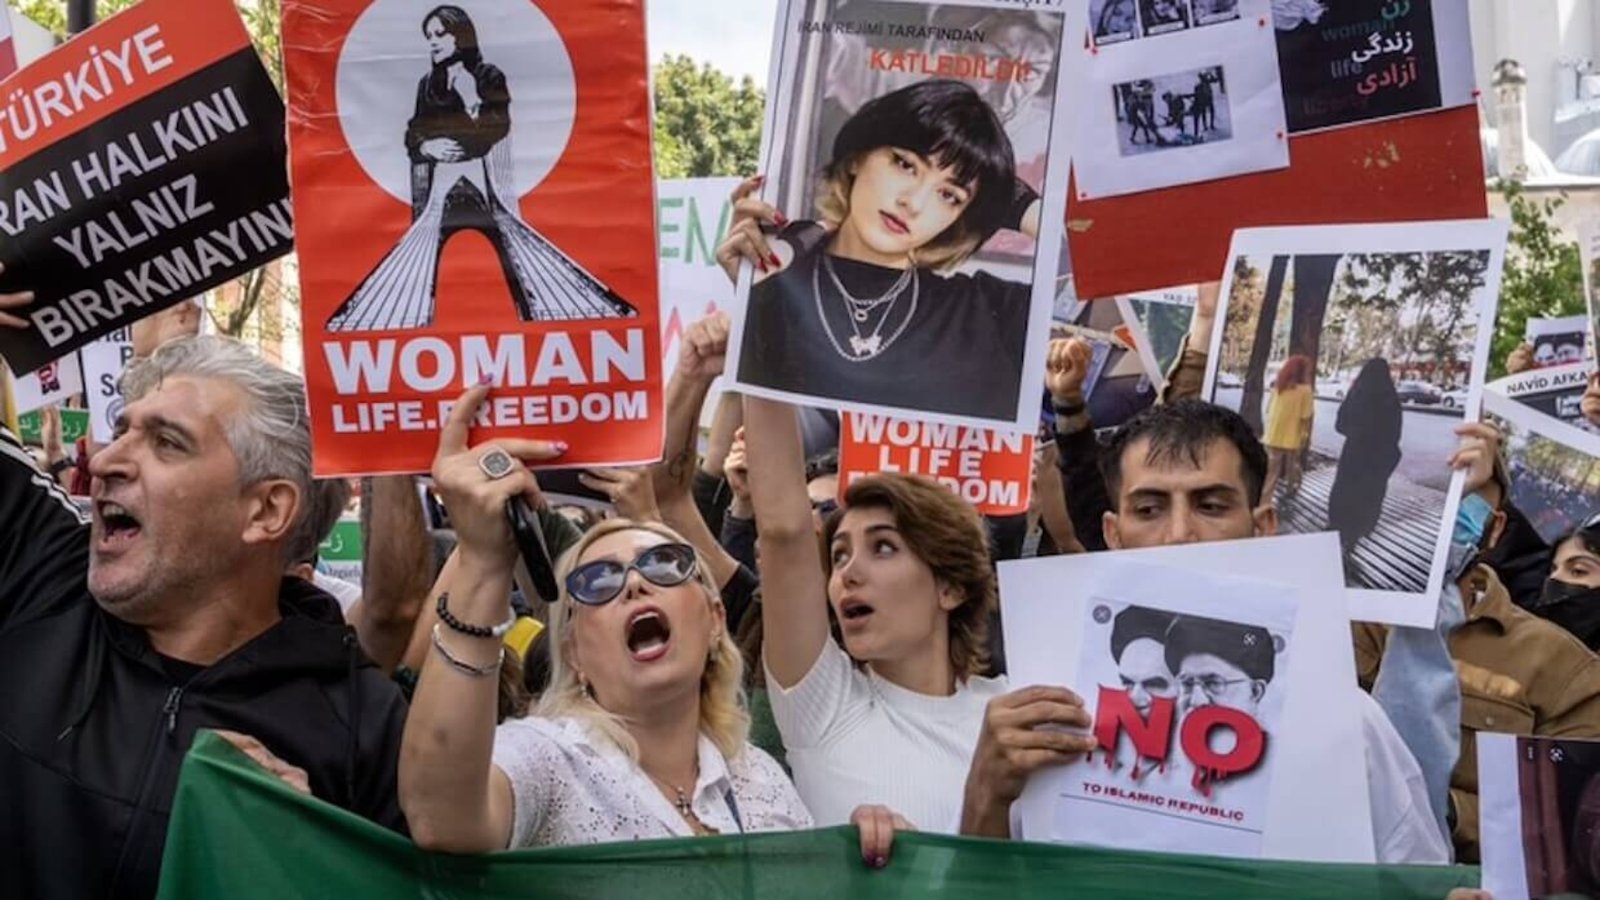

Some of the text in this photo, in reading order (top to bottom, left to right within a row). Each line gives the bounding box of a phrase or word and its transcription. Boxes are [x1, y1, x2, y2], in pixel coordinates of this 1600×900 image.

[885, 24, 986, 44] TARAFINDAN
[1351, 30, 1415, 63] زندگی
[1331, 58, 1363, 79] life
[1356, 56, 1418, 96] آزادی
[0, 86, 249, 237] RAN HALKINI
[53, 173, 215, 269] YALNIZ
[322, 328, 648, 396] WOMAN
[1553, 372, 1587, 385] AFKA
[852, 413, 1021, 453] WOMAN
[880, 445, 982, 477] LIFE
[1093, 684, 1268, 792] NO
[1083, 782, 1245, 822] TO ISLAMIC REPUBLIC
